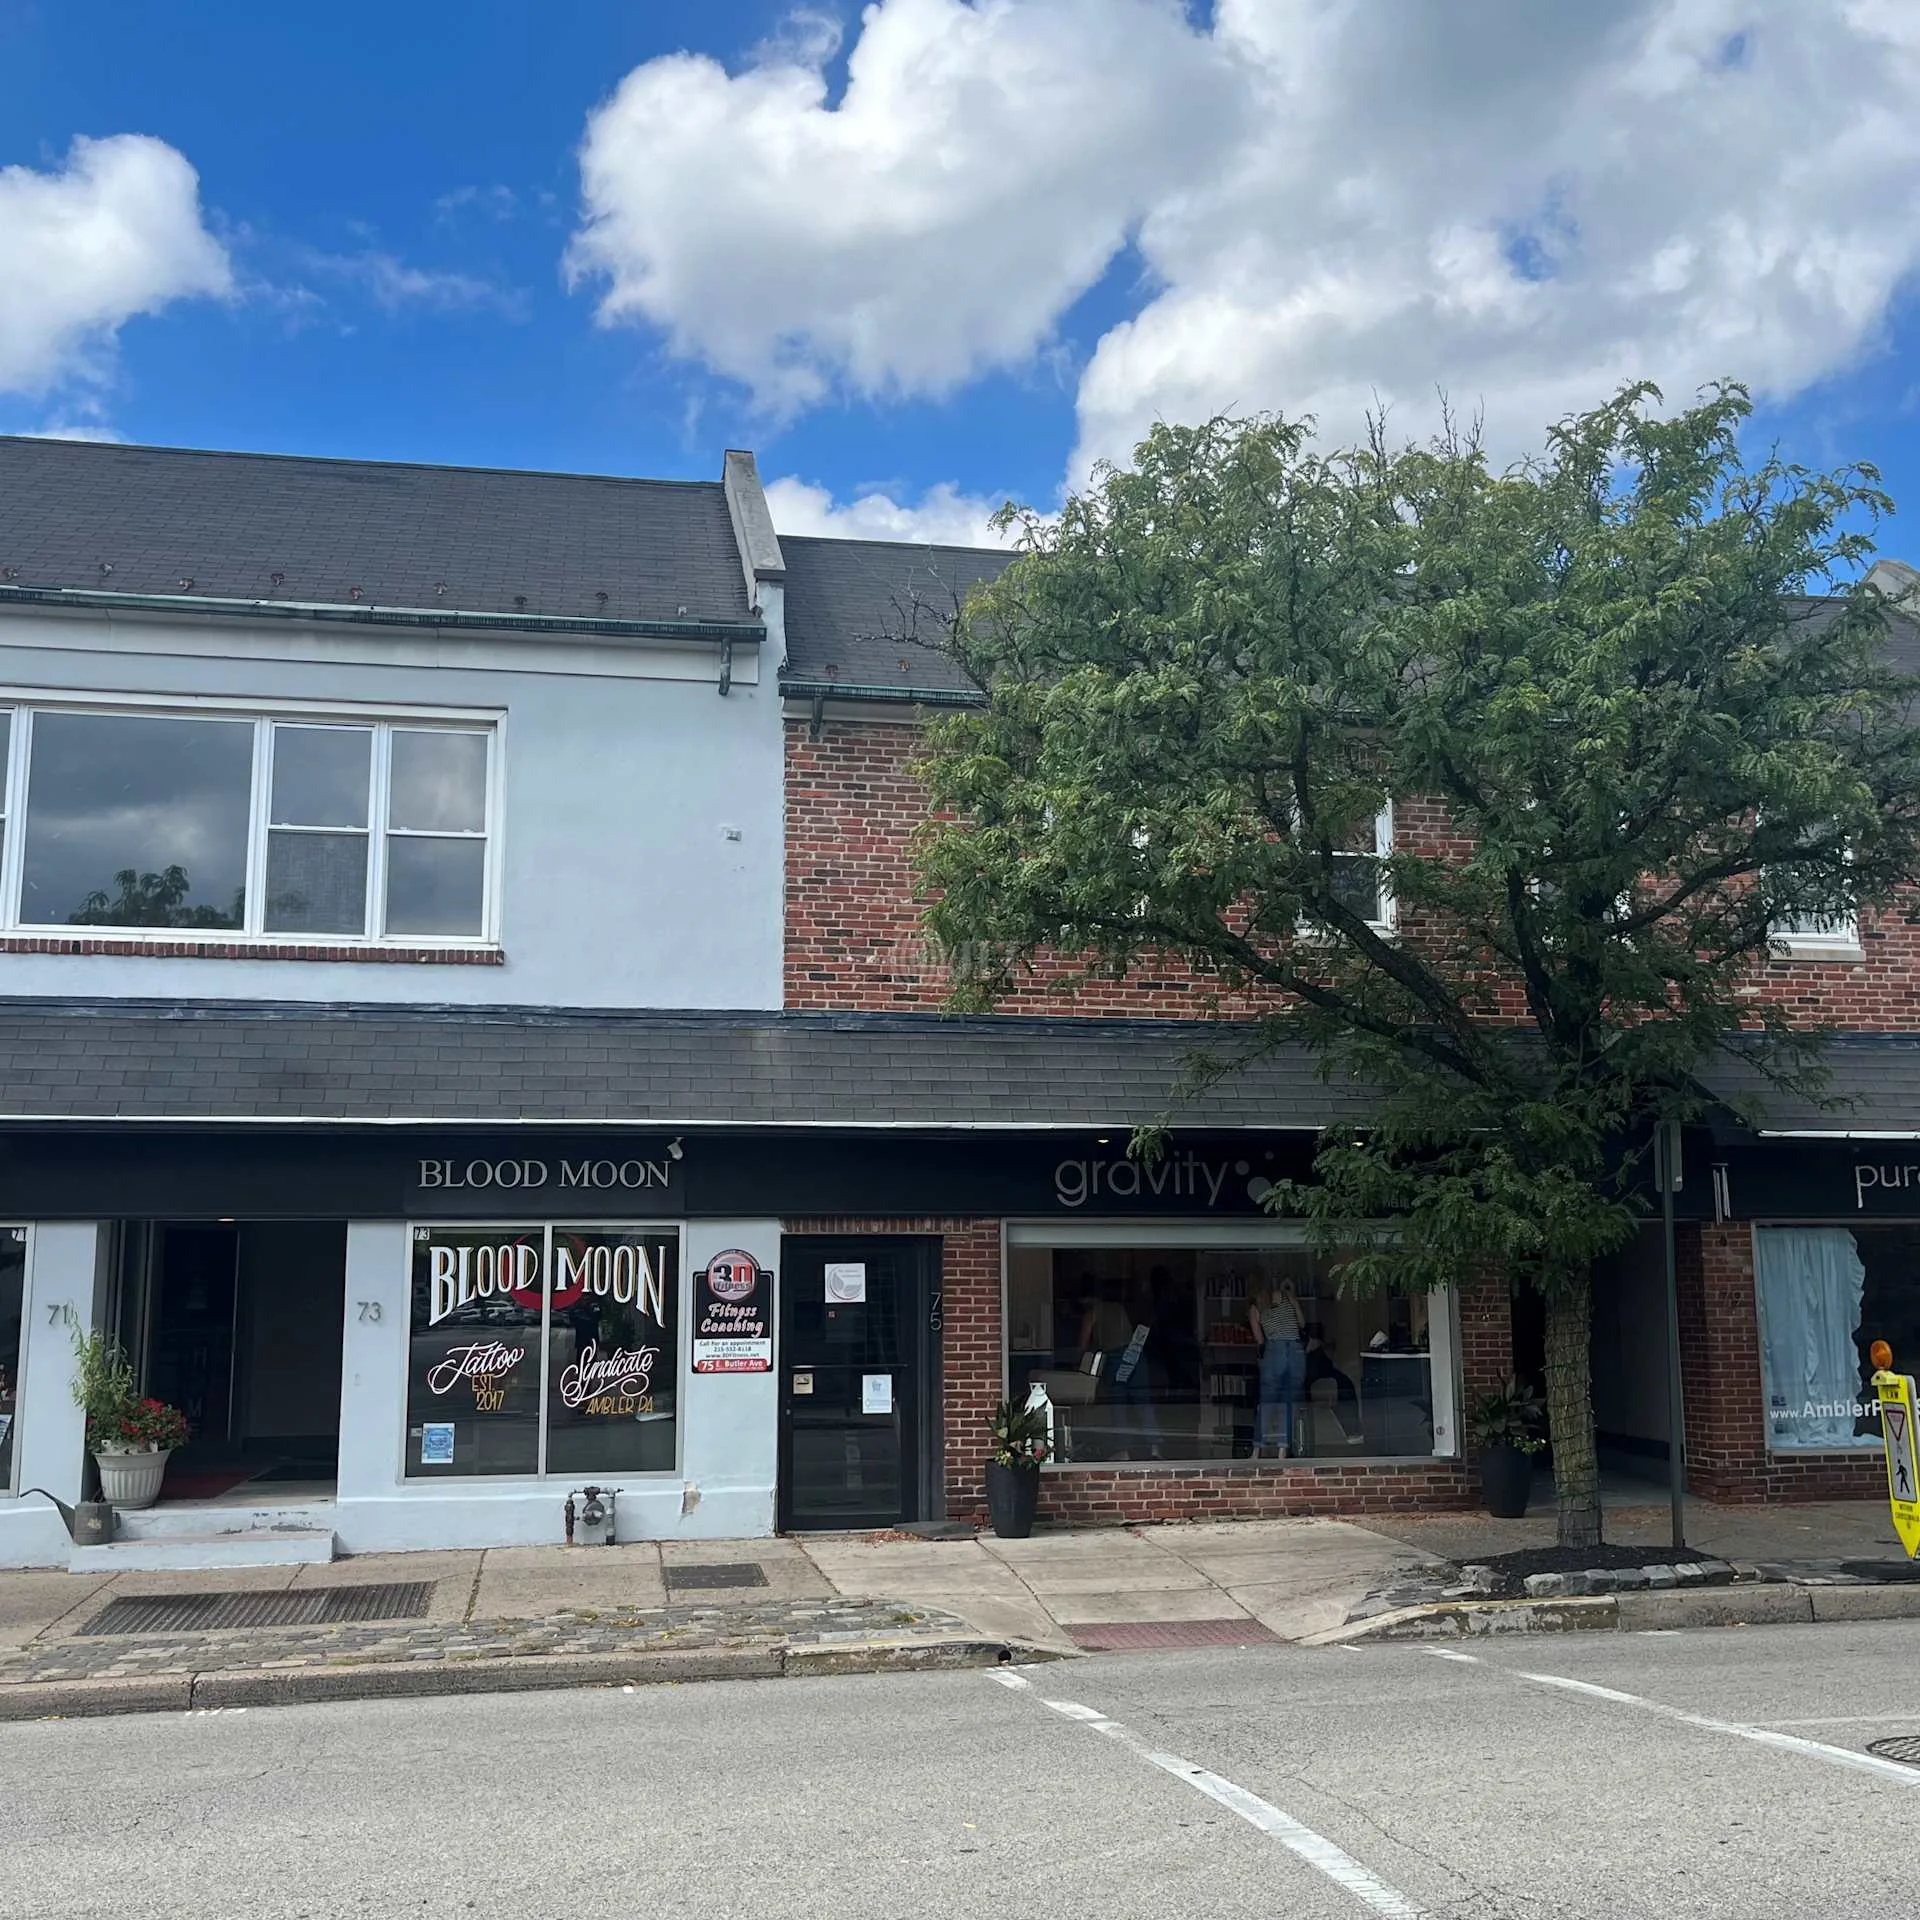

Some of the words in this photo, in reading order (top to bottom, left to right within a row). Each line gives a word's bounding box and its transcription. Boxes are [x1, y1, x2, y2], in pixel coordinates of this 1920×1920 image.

[418, 1160, 548, 1188] BLOOD
[558, 1160, 672, 1188] MOON
[1054, 1149, 1231, 1207] gravity
[1855, 1165, 1920, 1208] pur
[429, 1245, 538, 1326] BLOOD
[555, 1245, 667, 1328] MOON
[47, 1304, 68, 1325] 71
[357, 1302, 381, 1323] 73
[708, 1303, 757, 1318] Fitness
[700, 1315, 764, 1338] Coaching
[428, 1341, 524, 1394] Tattoo
[560, 1339, 660, 1407] Syndicate
[701, 1360, 714, 1371] 75
[476, 1391, 504, 1411] 2017
[585, 1396, 634, 1415] AMBLER
[637, 1396, 653, 1413] PA
